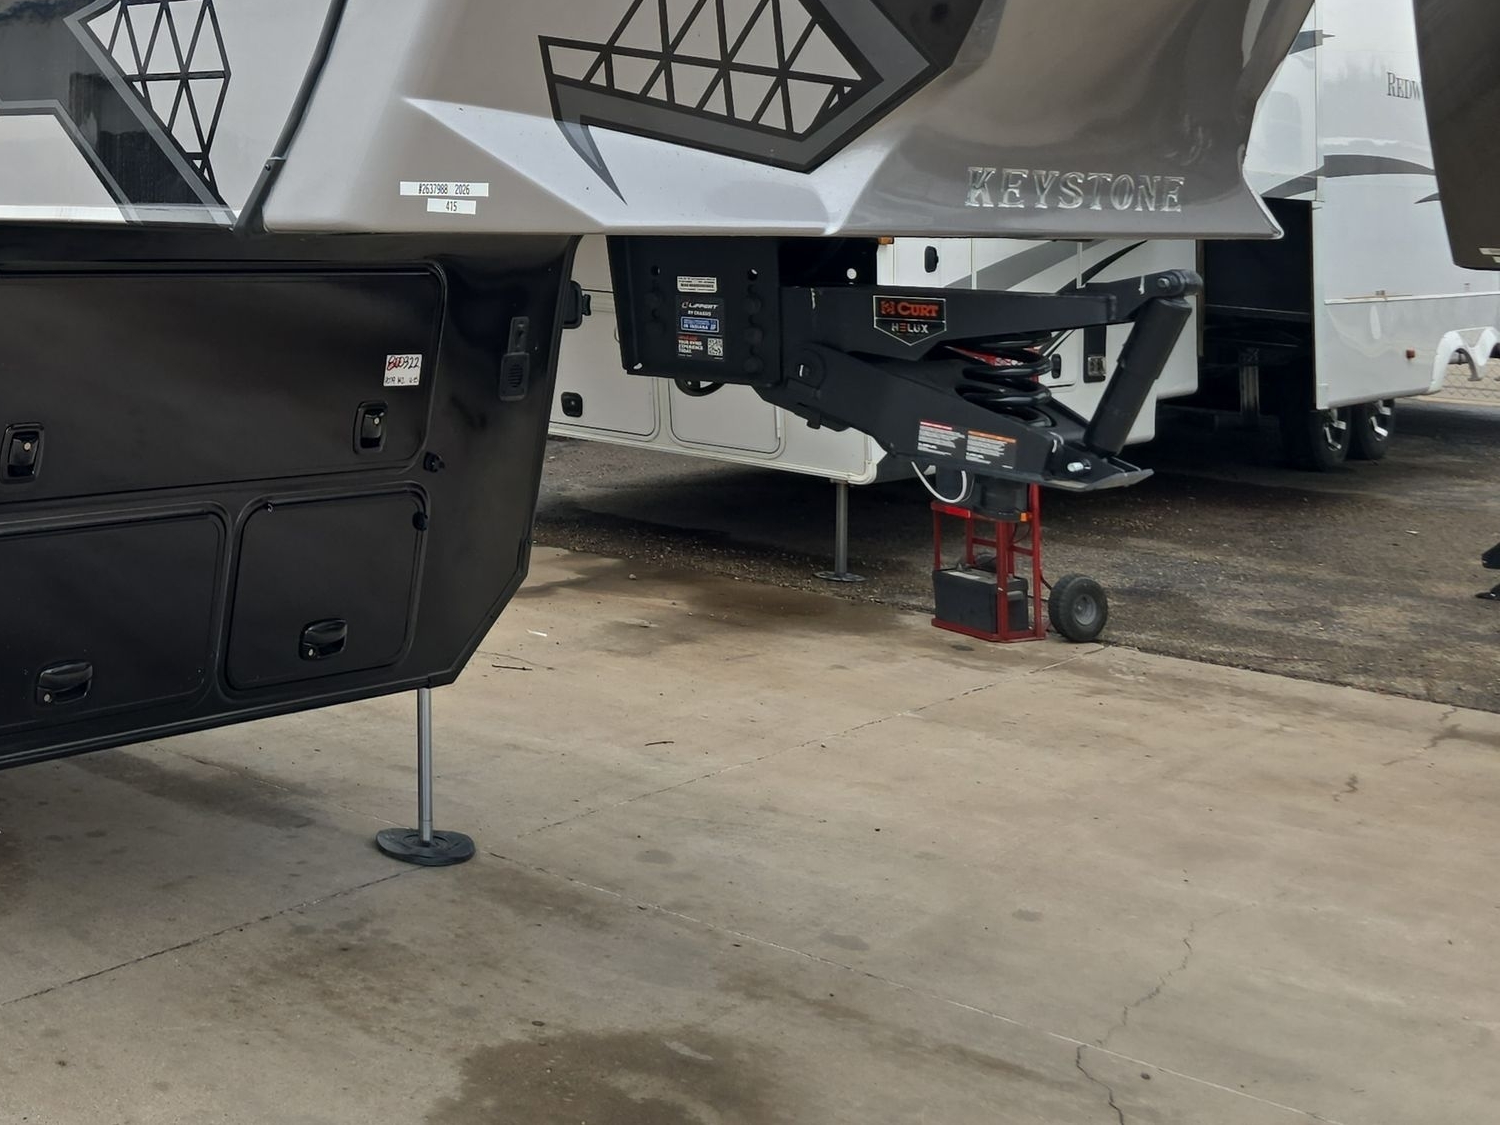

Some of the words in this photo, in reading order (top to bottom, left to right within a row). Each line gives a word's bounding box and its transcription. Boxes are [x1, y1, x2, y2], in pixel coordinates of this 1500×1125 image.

[455, 184, 471, 195] 2026
[964, 166, 1186, 213] KEYSTONE
[445, 201, 458, 212] 415
[897, 302, 939, 317] CURT
[891, 322, 929, 334] HELUX
